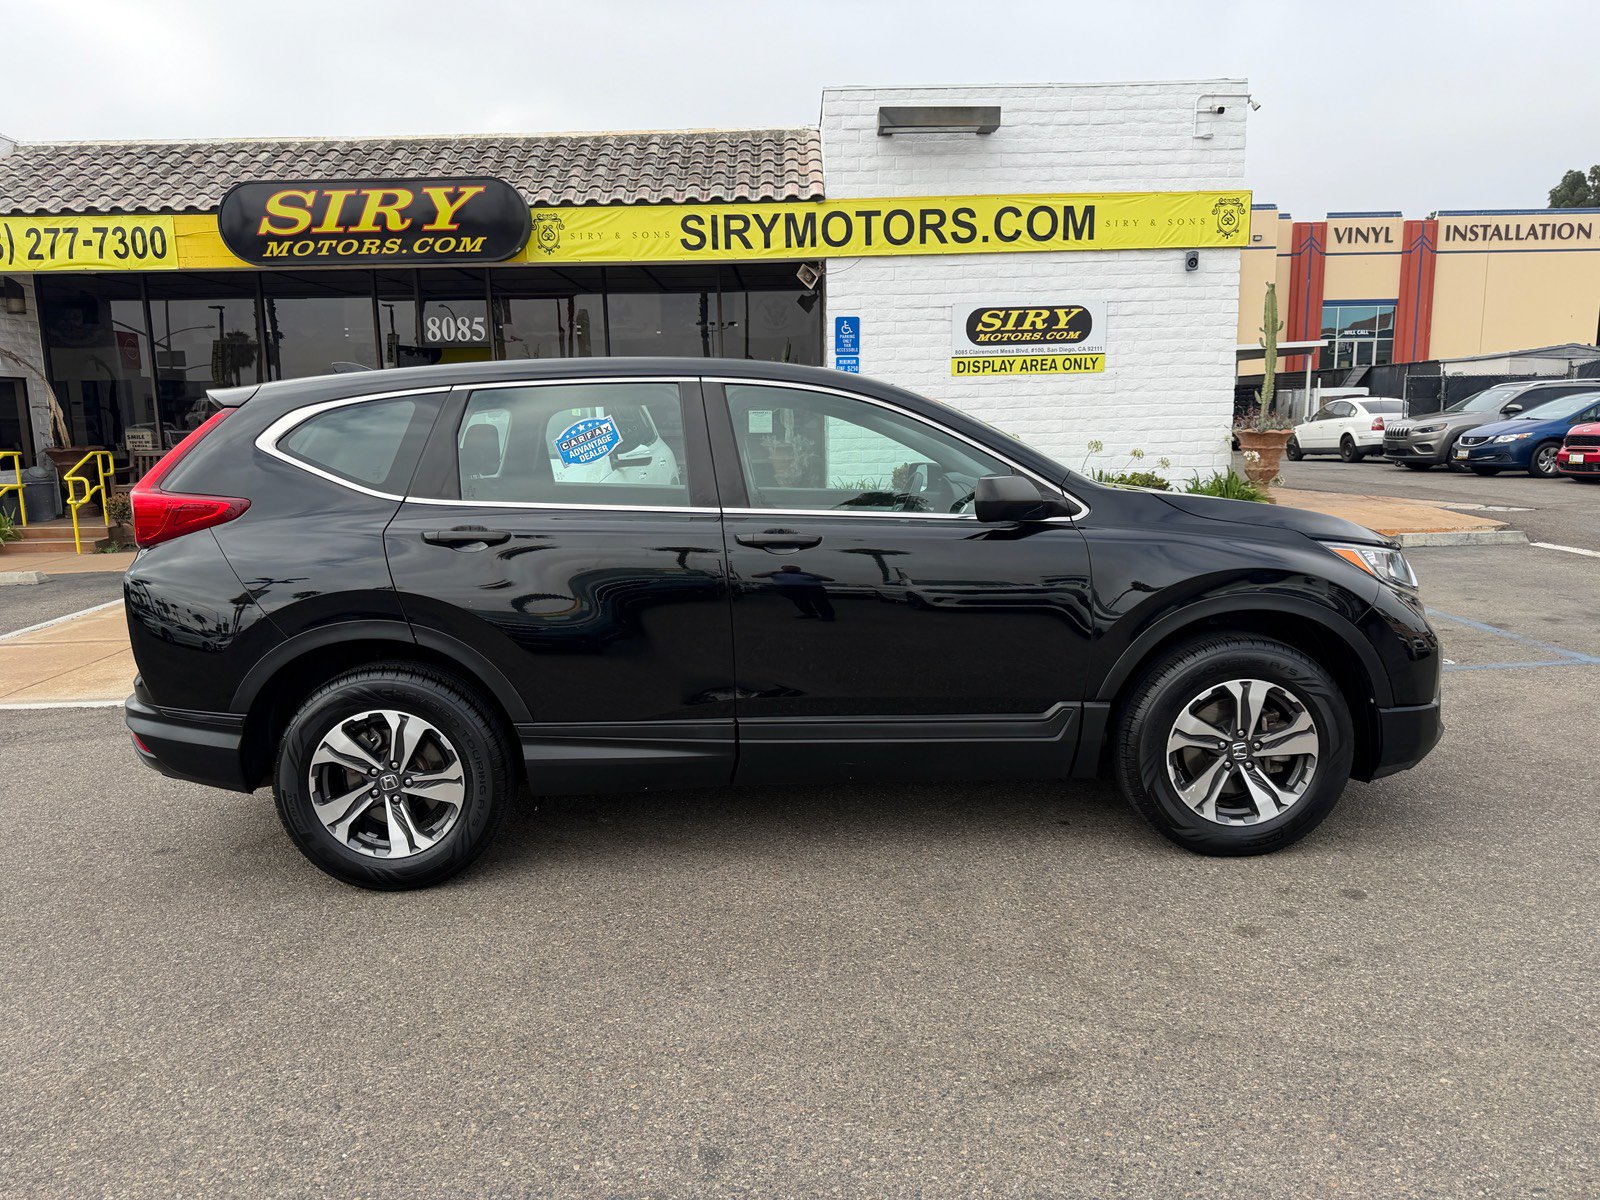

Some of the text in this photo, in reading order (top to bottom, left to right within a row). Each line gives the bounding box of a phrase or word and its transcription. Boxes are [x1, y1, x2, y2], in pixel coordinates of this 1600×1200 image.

[256, 185, 487, 236] SIRY
[680, 205, 1096, 250] SIRYMOTORS.COM
[1105, 218, 1206, 228] SIRY & SONS
[1334, 222, 1592, 244] VINYL INSTALLATION
[25, 226, 167, 260] 277-7300
[262, 236, 488, 258] MOTORS.COM
[570, 231, 671, 240] SIRY & SONS
[426, 316, 486, 342] 8085
[976, 308, 1084, 332] SIRY
[976, 331, 1082, 342] MOTORS.COM
[956, 357, 1099, 373] DISPLAY AREA ONLY
[560, 424, 612, 450] CARFAX
[569, 434, 612, 458] ADVANTAGE
[579, 444, 609, 462] DEALER
